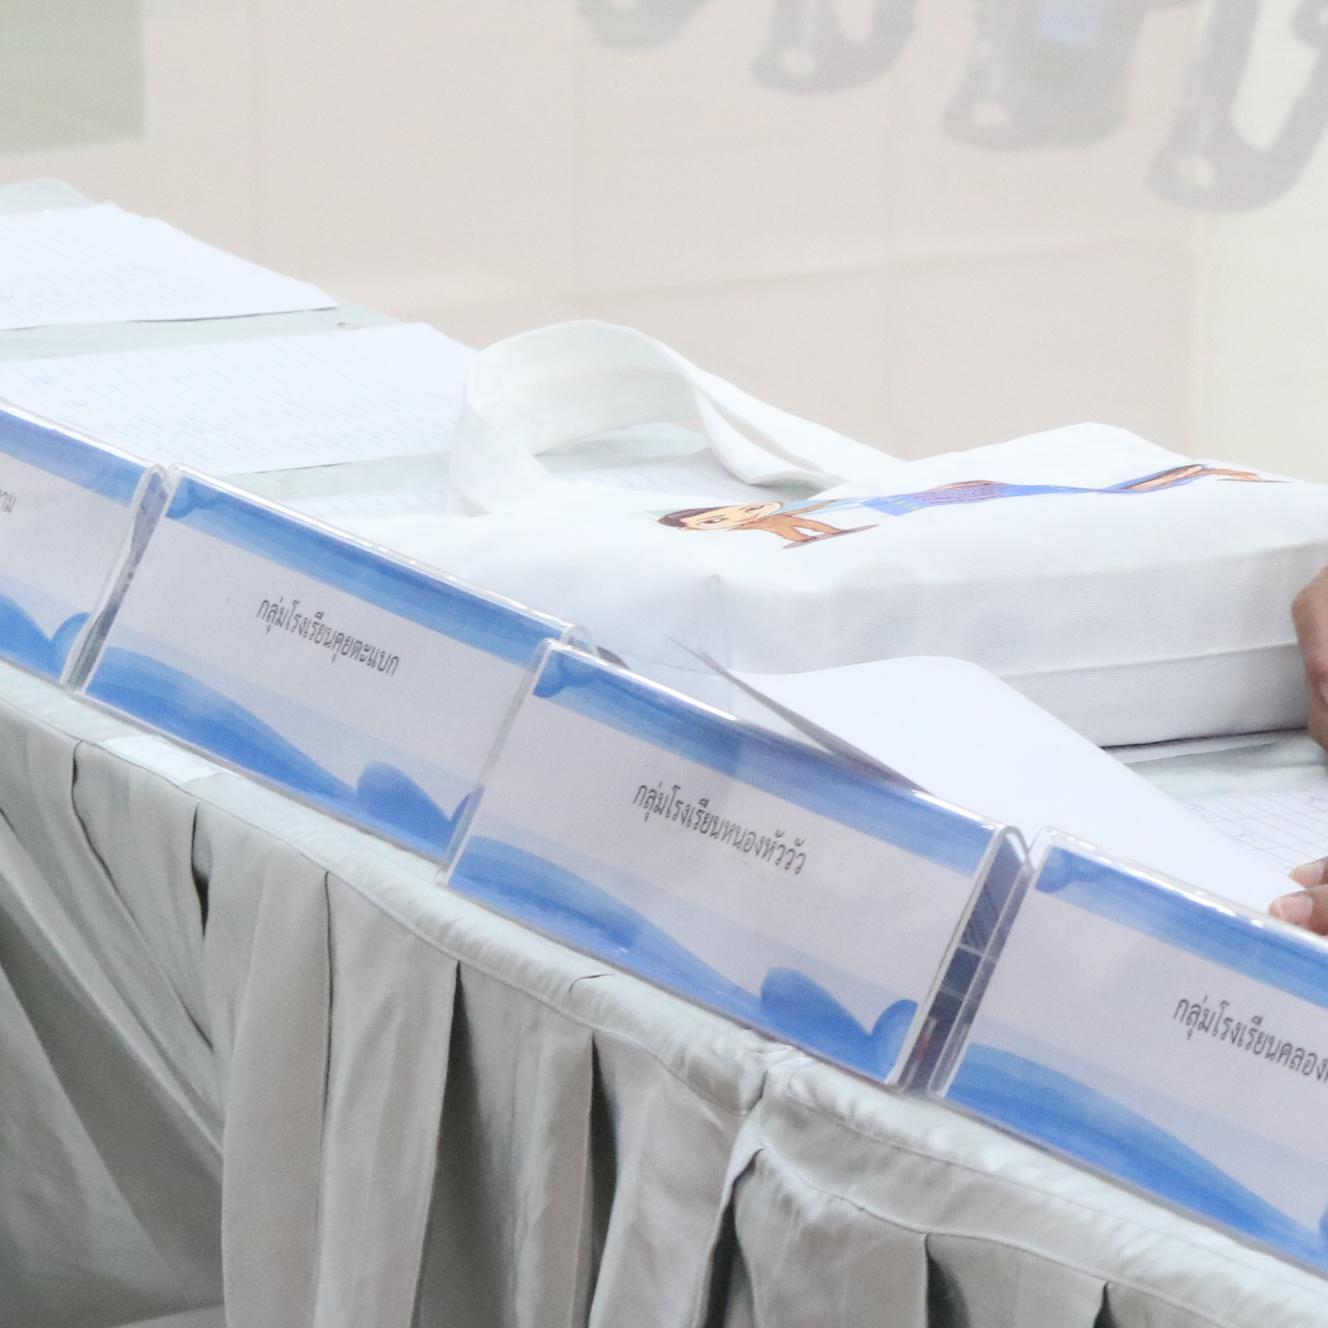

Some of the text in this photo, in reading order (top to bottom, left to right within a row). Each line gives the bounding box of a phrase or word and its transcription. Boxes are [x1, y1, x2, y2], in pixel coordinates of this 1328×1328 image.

[632, 781, 806, 874] กลุ่มโรงเรียนหนองหัววัว
